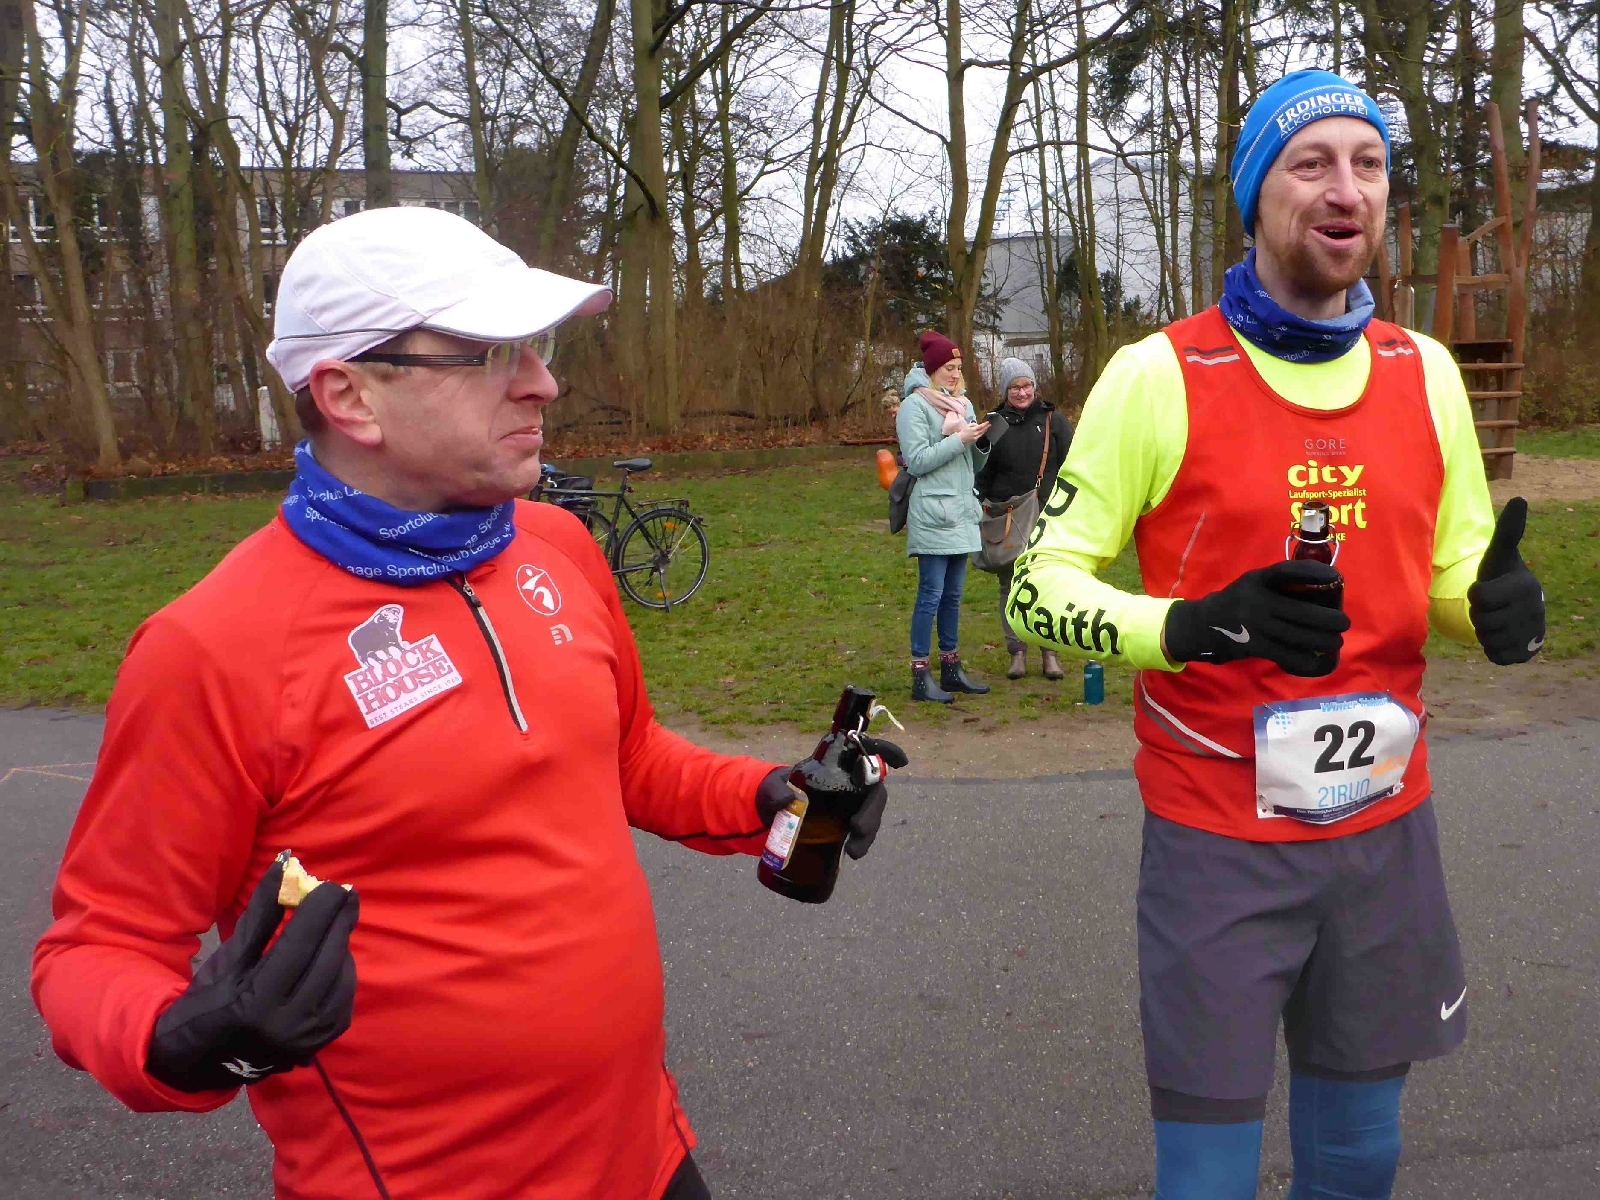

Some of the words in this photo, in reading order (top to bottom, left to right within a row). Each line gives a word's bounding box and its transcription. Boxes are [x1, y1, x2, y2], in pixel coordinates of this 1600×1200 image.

[1276, 93, 1367, 130] ERDINGER
[1280, 104, 1369, 138] ALKOHOLFREI
[1304, 438, 1346, 450] GORE
[1287, 459, 1365, 487] city
[1288, 488, 1367, 500] Laufsport-Spezialist
[1290, 498, 1368, 529] Sort
[1010, 578, 1121, 655] Raith
[347, 637, 443, 695] BLOCK
[358, 655, 453, 715] HOUSE
[369, 712, 388, 725] BEST
[390, 696, 419, 715] STEAKS
[420, 684, 443, 698] SINCE
[1313, 720, 1375, 773] 22
